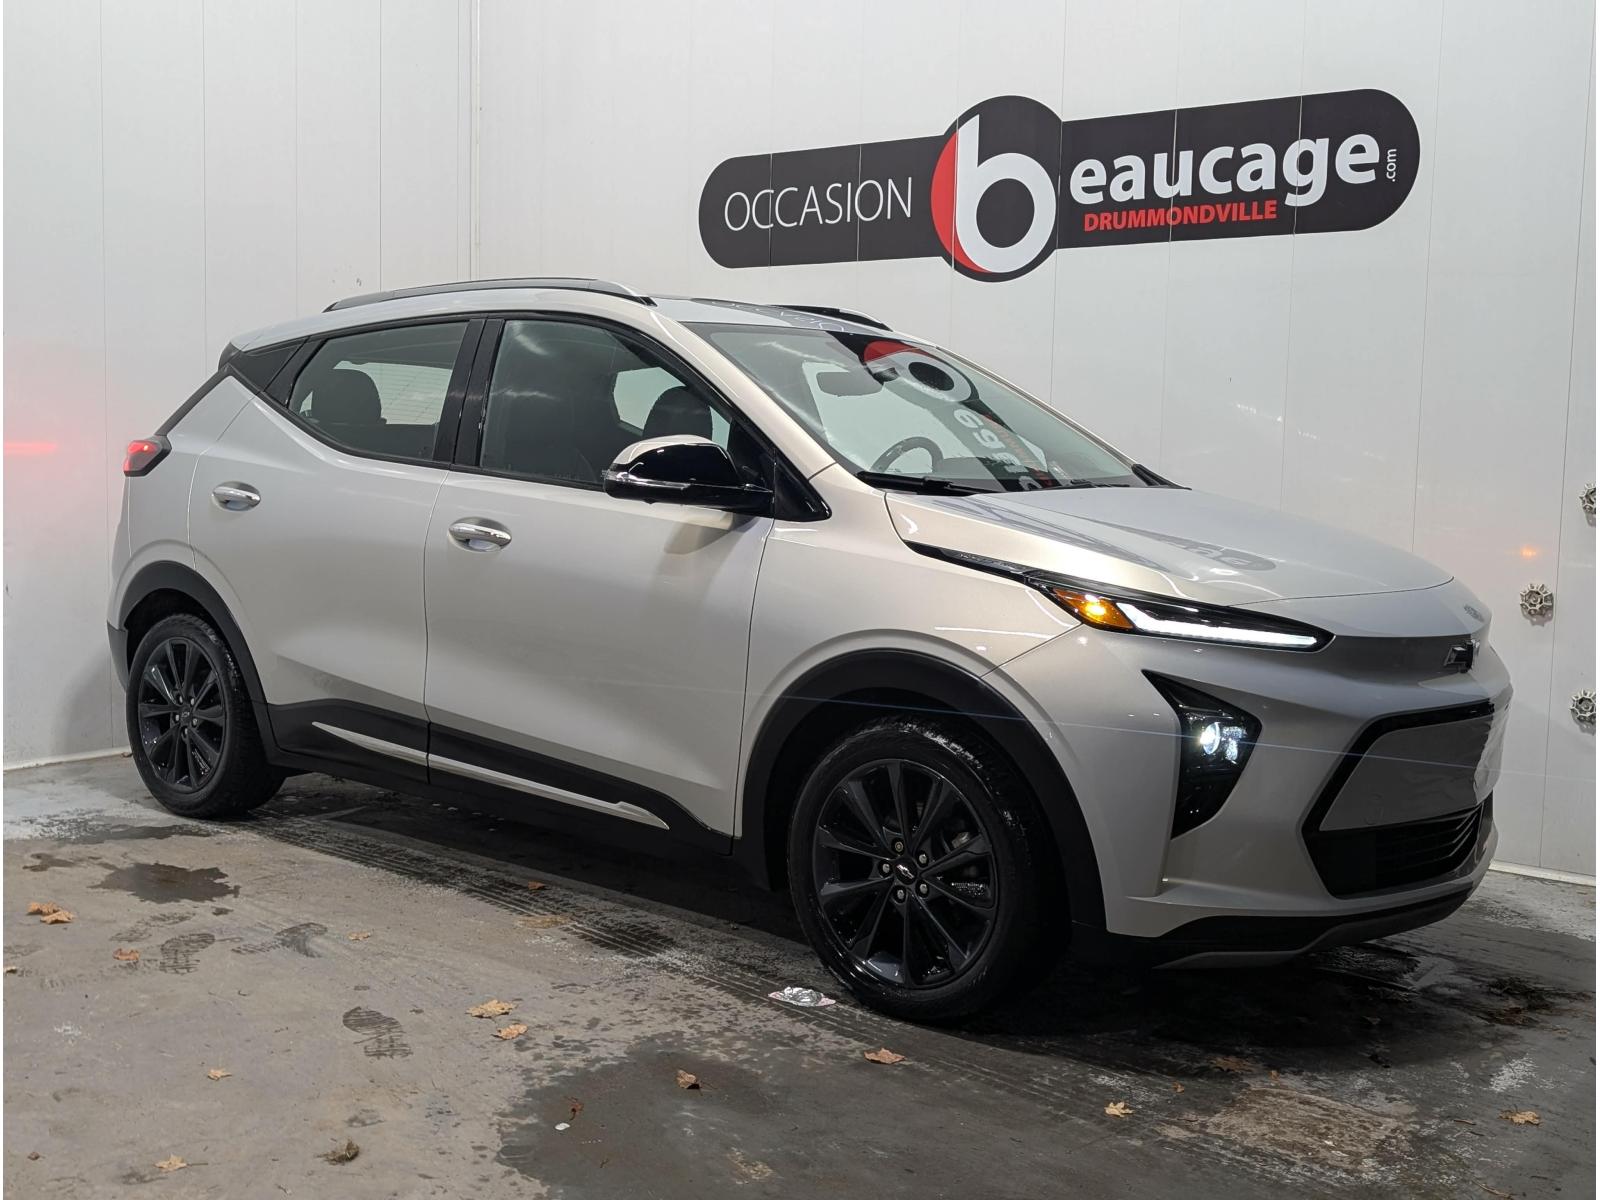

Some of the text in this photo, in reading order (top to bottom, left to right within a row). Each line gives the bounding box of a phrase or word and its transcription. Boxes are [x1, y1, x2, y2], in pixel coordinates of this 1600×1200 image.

[1386, 148, 1397, 182] .com
[724, 177, 912, 231] OCCASION
[1083, 200, 1278, 232] DRUMMONDVILLE
